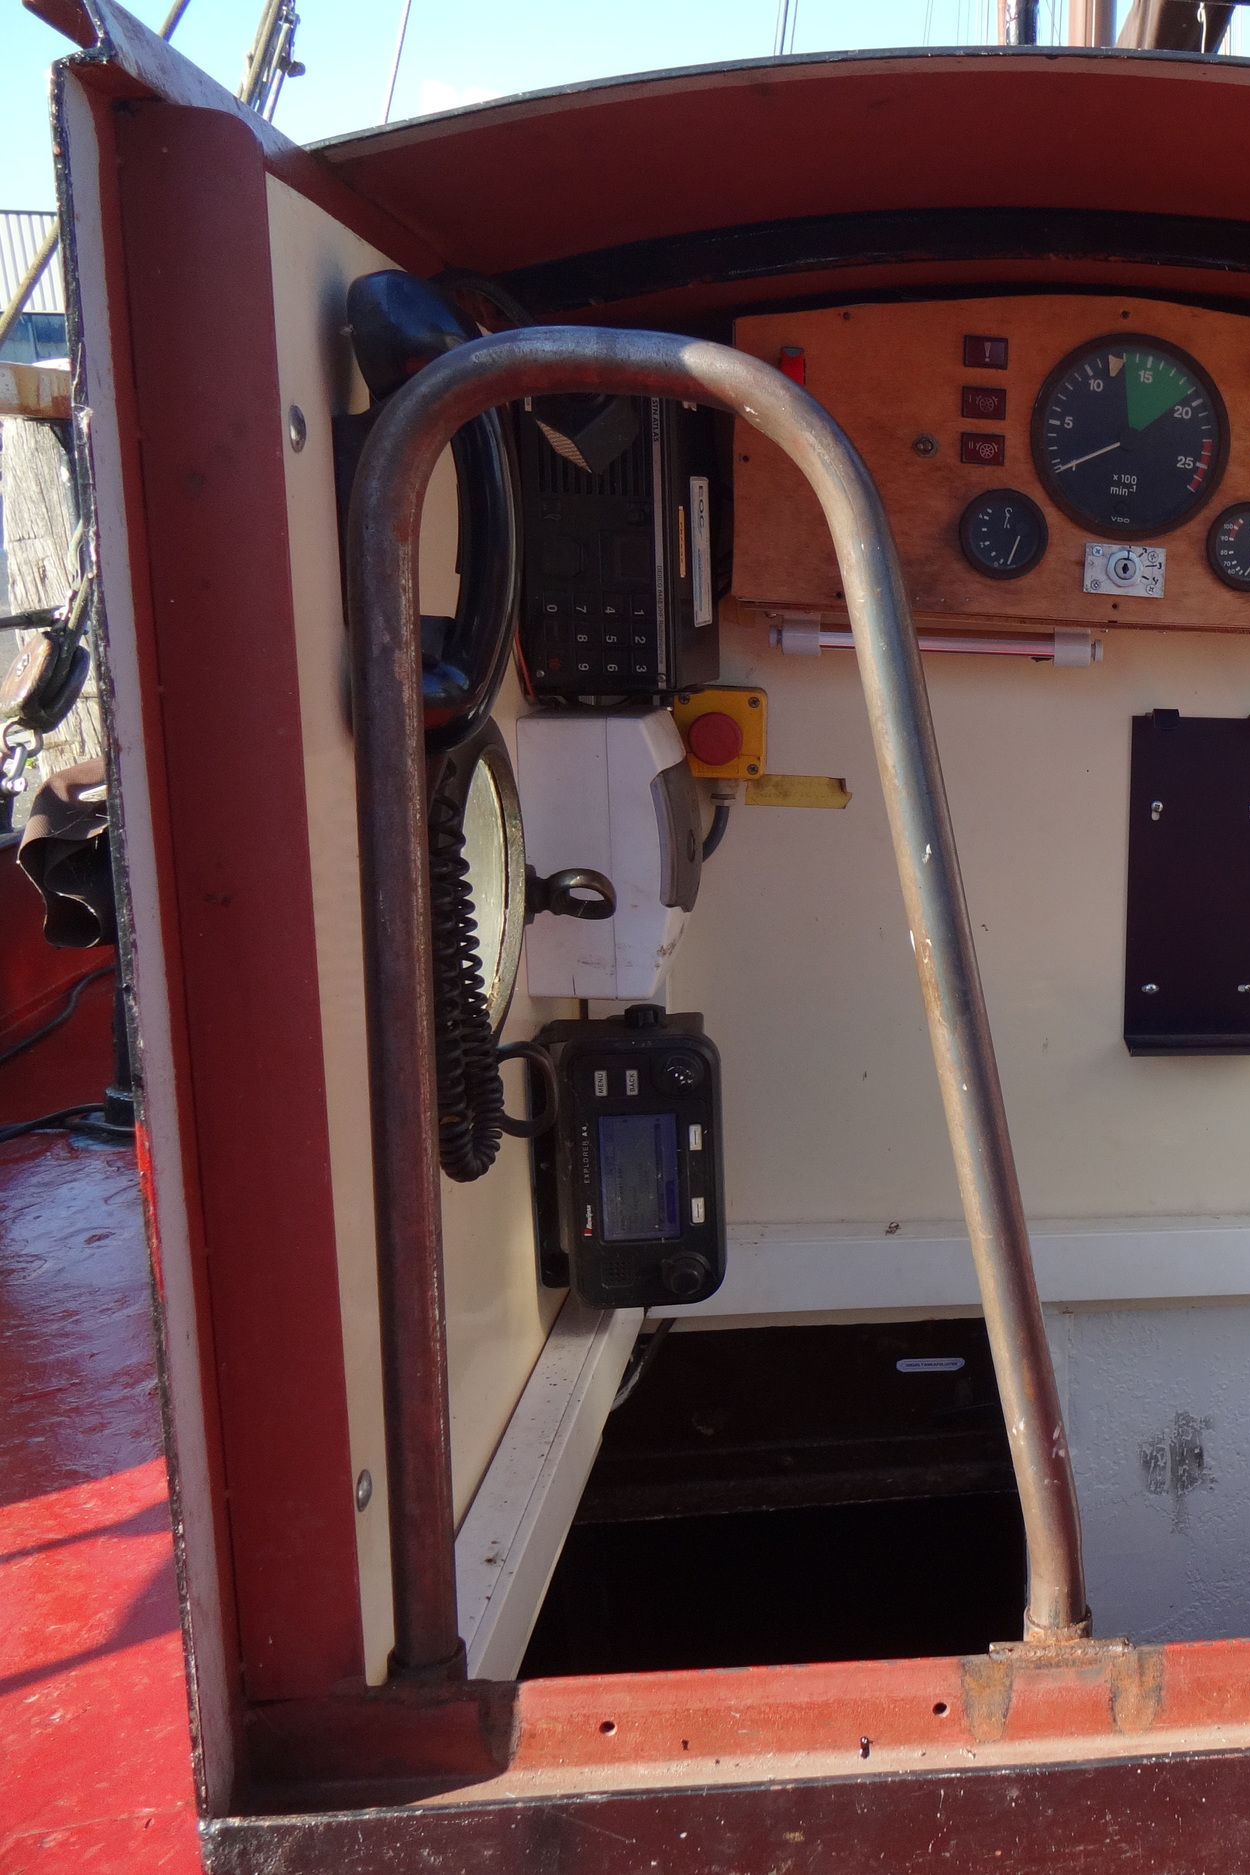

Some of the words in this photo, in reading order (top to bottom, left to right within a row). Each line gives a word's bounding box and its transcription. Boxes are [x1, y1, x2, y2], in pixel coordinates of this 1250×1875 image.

[1138, 370, 1153, 384] 15
[1088, 379, 1104, 392] 10
[1173, 406, 1192, 419] 20
[1064, 417, 1073, 429] 5
[1177, 456, 1194, 469] 25
[1121, 474, 1137, 485] 100
[576, 605, 587, 614] 7
[605, 606, 616, 614] 4
[577, 634, 588, 642] 8
[606, 635, 617, 643] 5
[635, 636, 645, 644] 2
[578, 663, 589, 671] 9
[636, 665, 646, 673] 3
[582, 1140, 590, 1184] EXPLORER
